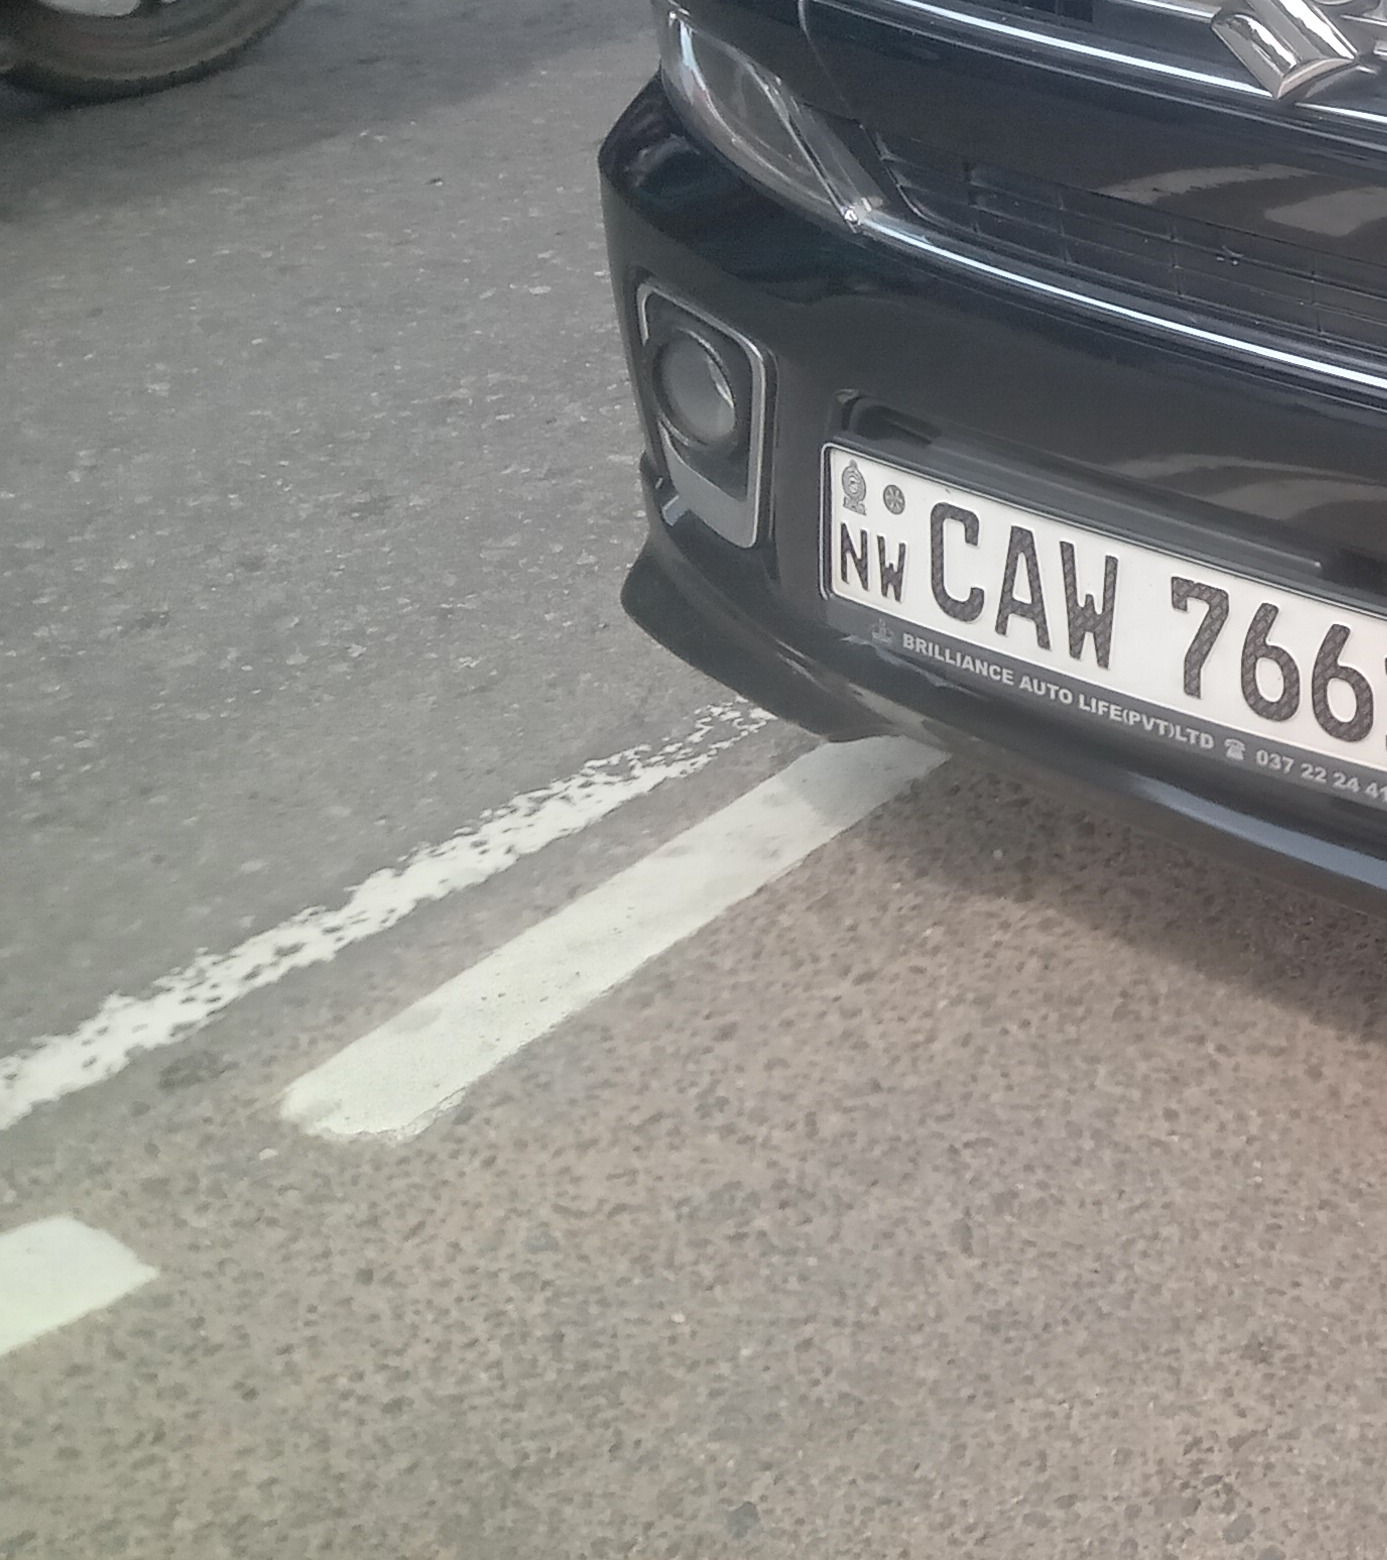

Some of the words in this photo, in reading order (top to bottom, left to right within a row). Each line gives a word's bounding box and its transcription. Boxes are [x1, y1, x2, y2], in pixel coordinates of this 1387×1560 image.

[841, 522, 906, 603] NW
[930, 502, 1118, 670] CAW
[902, 634, 1015, 686] BRILLIANCE
[1018, 675, 1073, 705] AUTO
[1078, 693, 1215, 750] LIFE(PVT)LTD
[1255, 749, 1294, 774] 037
[1300, 762, 1327, 784] 22
[1332, 772, 1361, 793] 24
